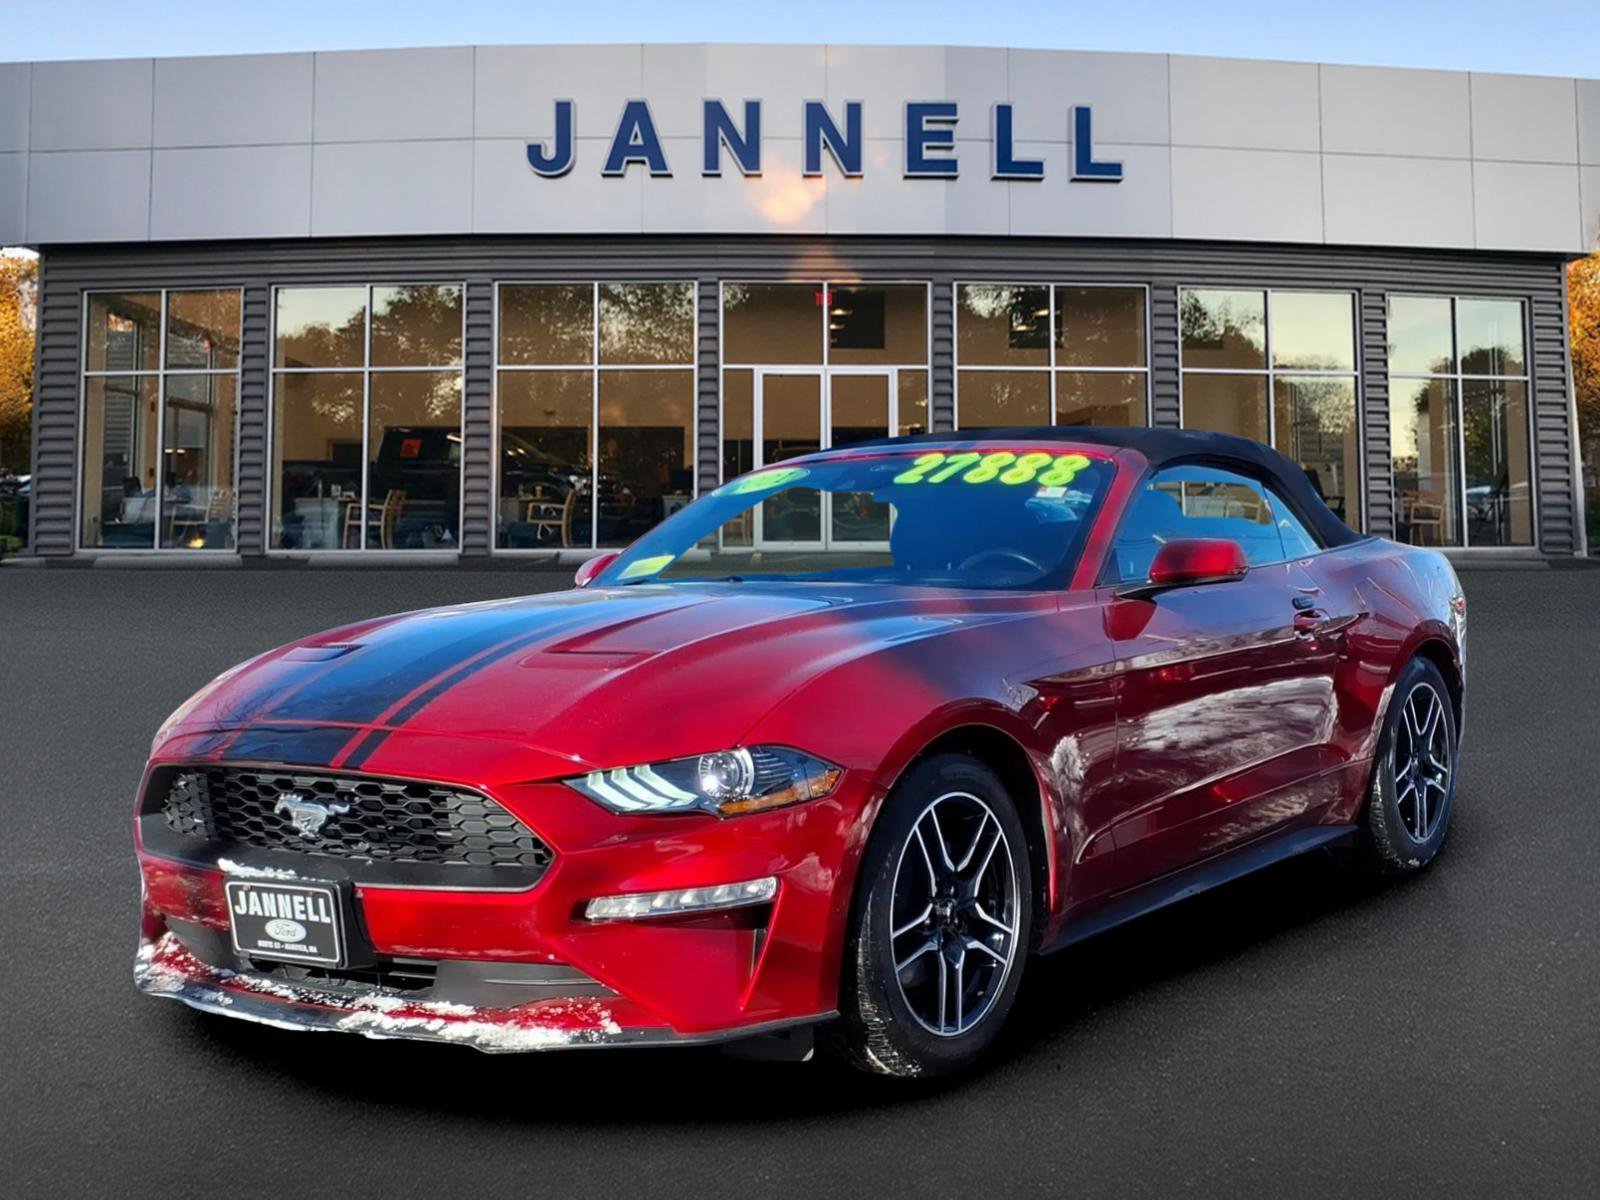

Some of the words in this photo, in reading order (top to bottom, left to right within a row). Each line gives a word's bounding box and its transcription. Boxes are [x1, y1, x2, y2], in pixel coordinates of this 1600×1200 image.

[525, 98, 1124, 182] JANNELL
[893, 452, 1091, 486] 27888
[234, 891, 331, 923] JANNELL
